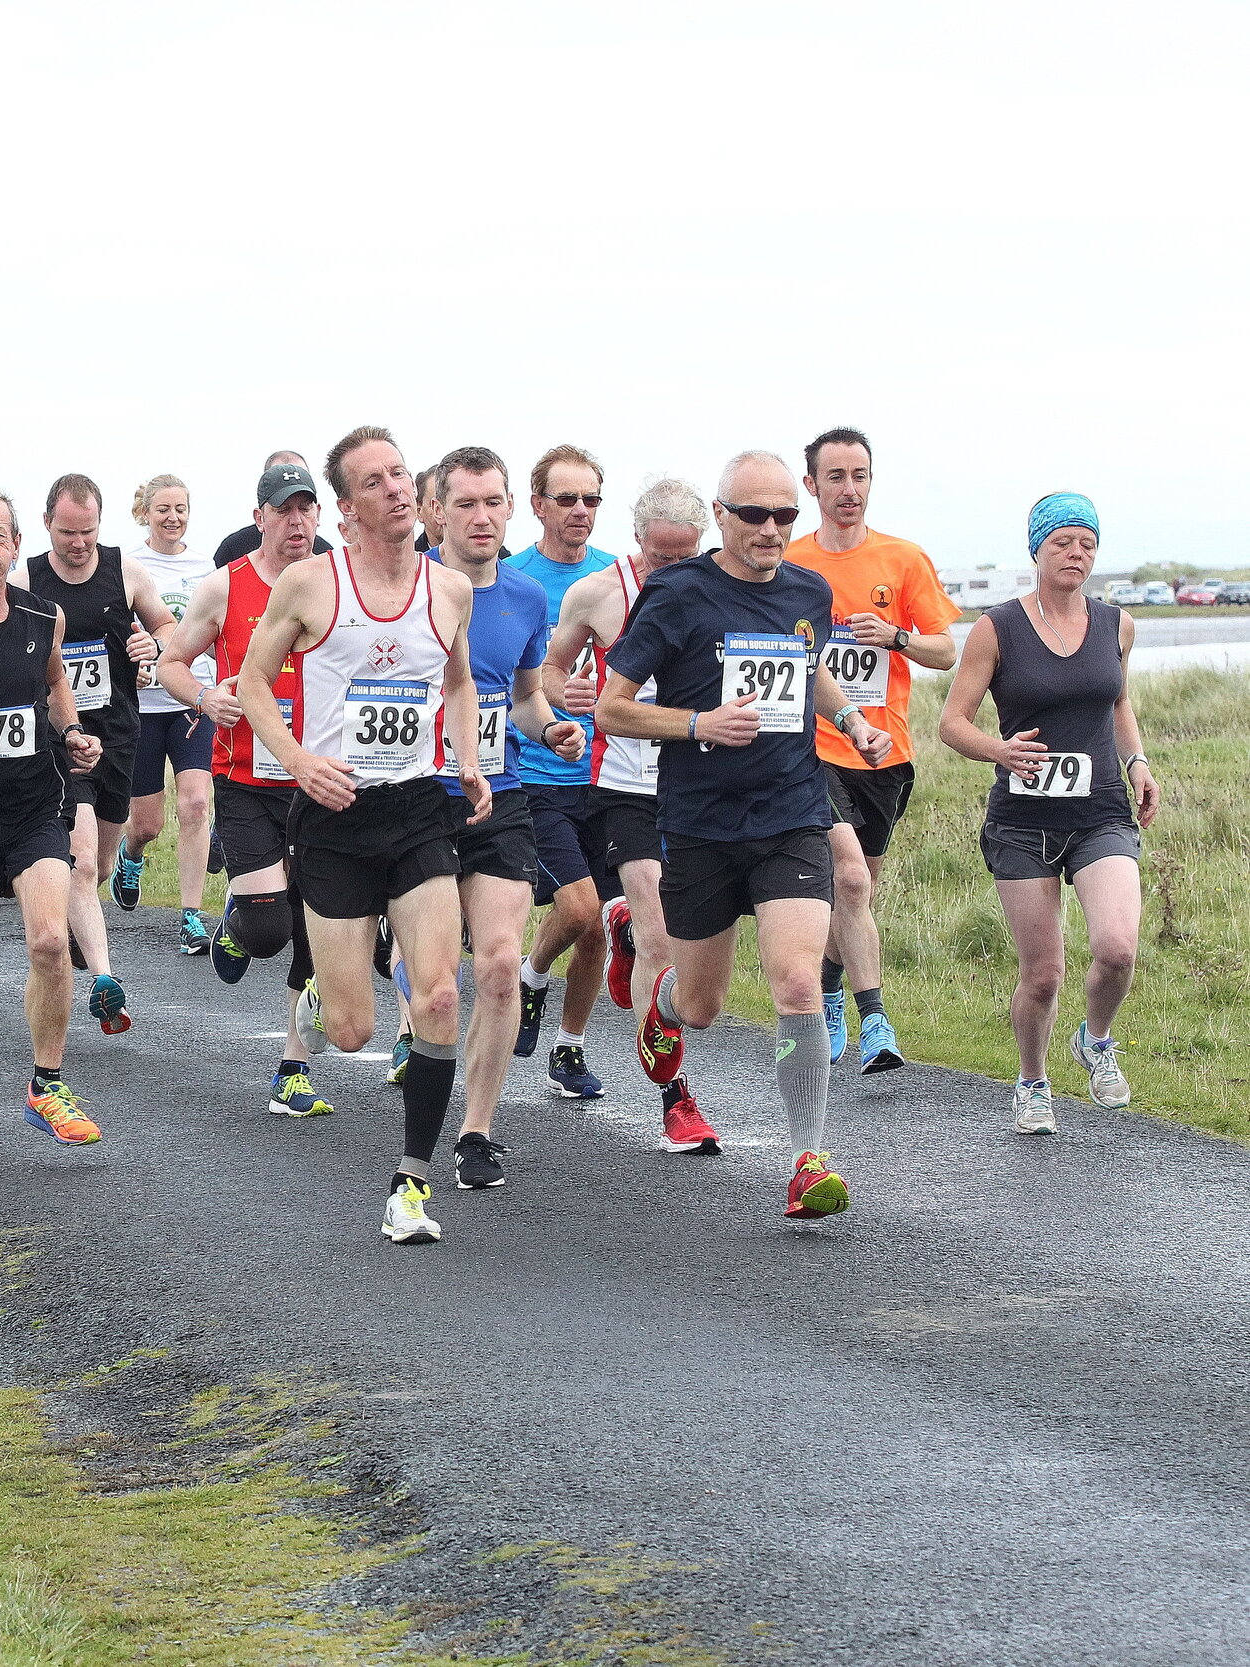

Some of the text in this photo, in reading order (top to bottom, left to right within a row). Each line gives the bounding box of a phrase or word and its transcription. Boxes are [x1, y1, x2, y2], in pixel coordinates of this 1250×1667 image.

[835, 630, 856, 639] BUCK
[61, 644, 106, 656] UCKLEY SPORTS
[730, 640, 804, 652] JOHN BUCKLEY SPORTS
[825, 647, 878, 682] 409
[63, 659, 101, 691] 73
[737, 660, 795, 701] 392
[348, 685, 427, 698] JOHN BUCKLEY SPORTS
[488, 691, 506, 702] SPORTS
[356, 705, 419, 746] 388
